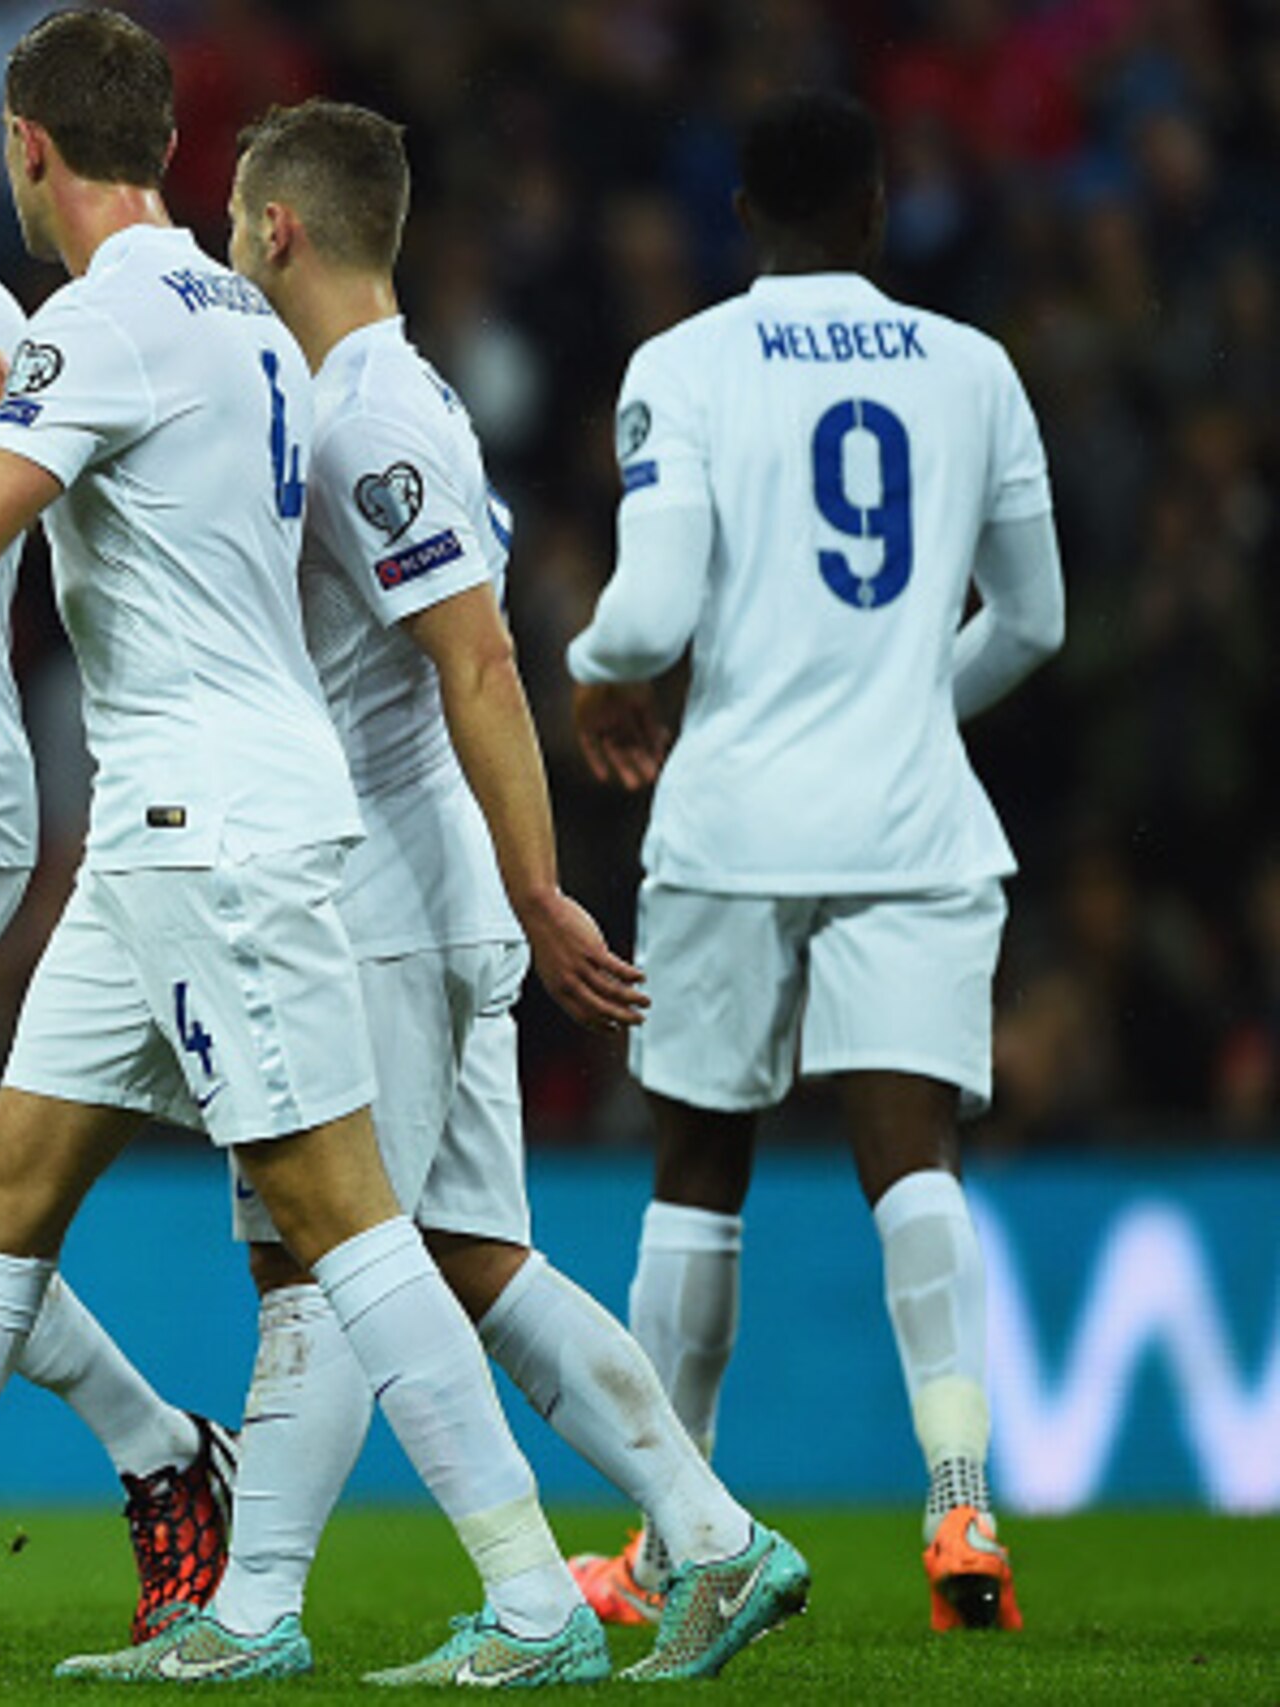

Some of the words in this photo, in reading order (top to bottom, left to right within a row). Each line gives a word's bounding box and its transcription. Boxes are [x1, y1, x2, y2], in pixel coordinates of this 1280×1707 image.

[757, 321, 926, 362] WELBECK
[811, 397, 914, 610] 9
[174, 982, 212, 1077] 4
